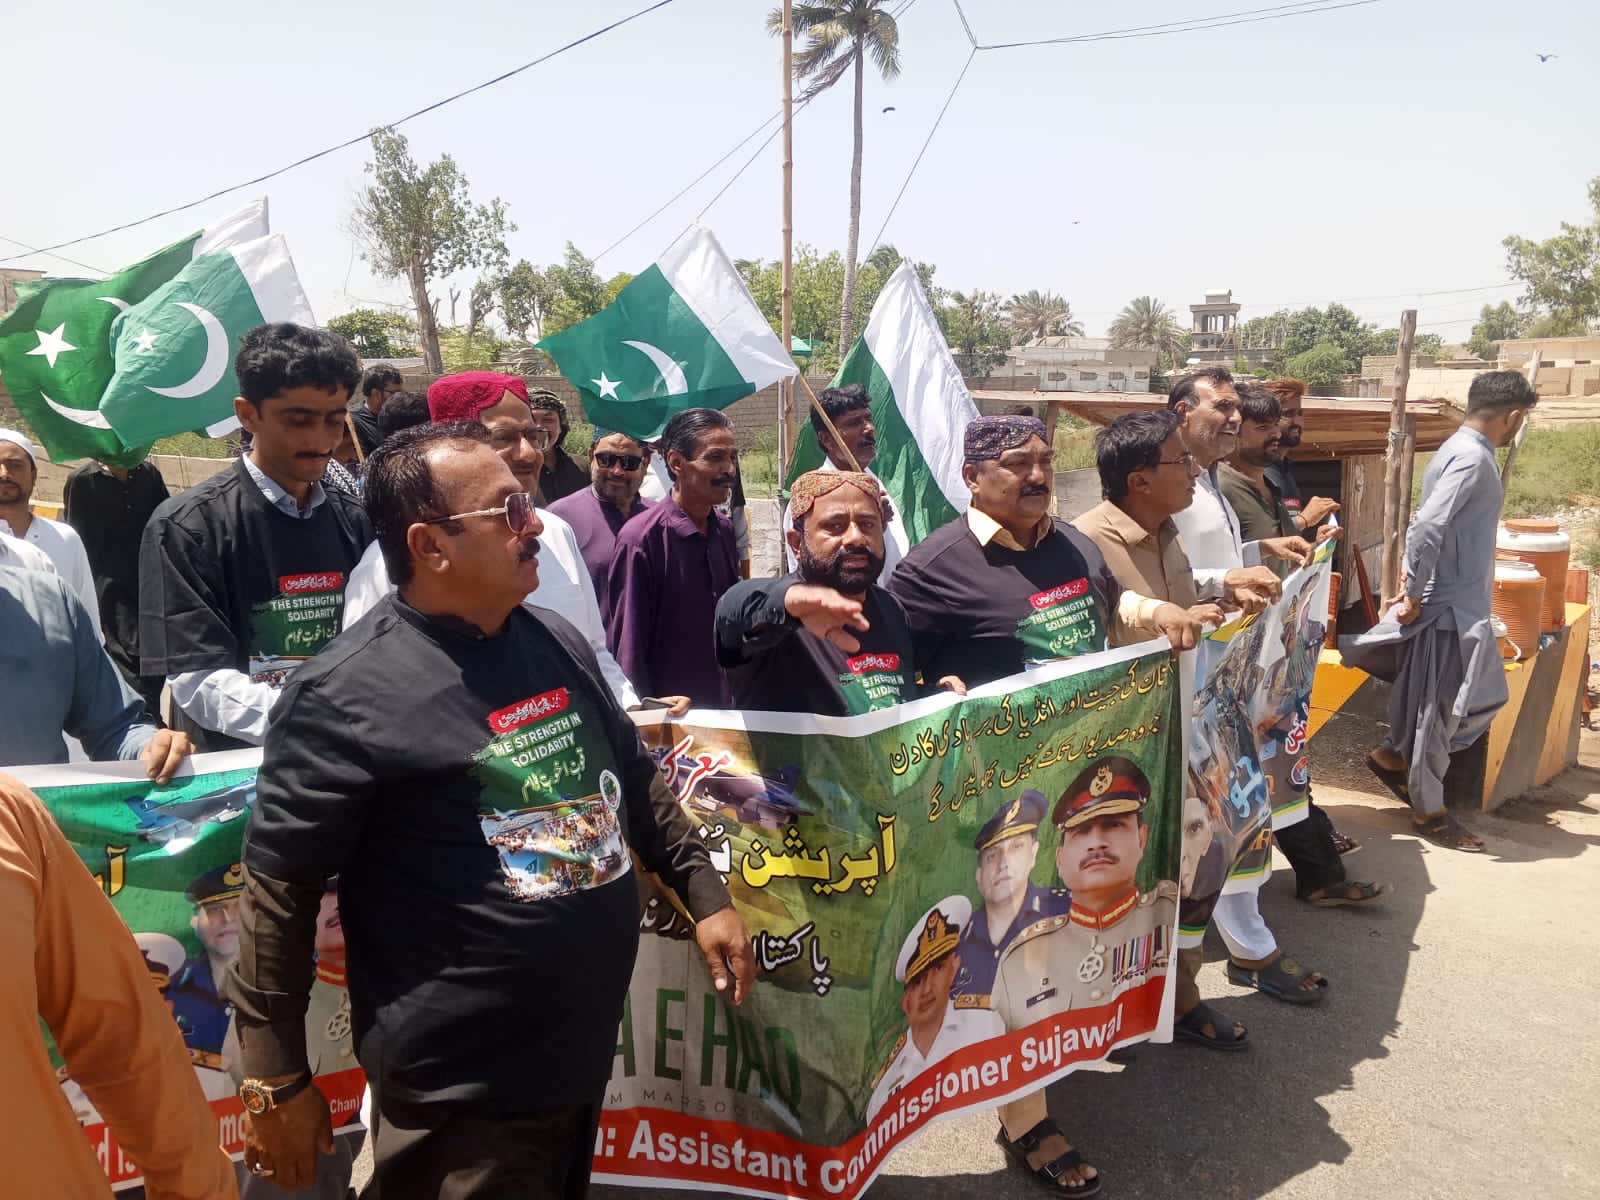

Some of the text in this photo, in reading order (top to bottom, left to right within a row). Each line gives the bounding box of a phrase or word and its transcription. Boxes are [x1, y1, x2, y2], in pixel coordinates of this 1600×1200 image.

[271, 600, 292, 611] THE
[292, 595, 335, 608] STRENGTH
[287, 607, 336, 622] SOLIDARITY
[1031, 612, 1046, 624] THE
[1046, 599, 1086, 619] STRENGTH
[1045, 609, 1090, 632] SOLIDARITY
[1057, 688, 1081, 717] اور
[1082, 682, 1122, 713] جیت
[491, 711, 582, 757] THE STRENGTH IN
[1017, 695, 1057, 740] انڈیا
[511, 733, 576, 768] SOLIDARITY
[660, 734, 735, 803] معرک
[741, 812, 897, 896] آپریشن
[1020, 1003, 1123, 1073] Sujawal
[627, 1119, 808, 1188] Assistant
